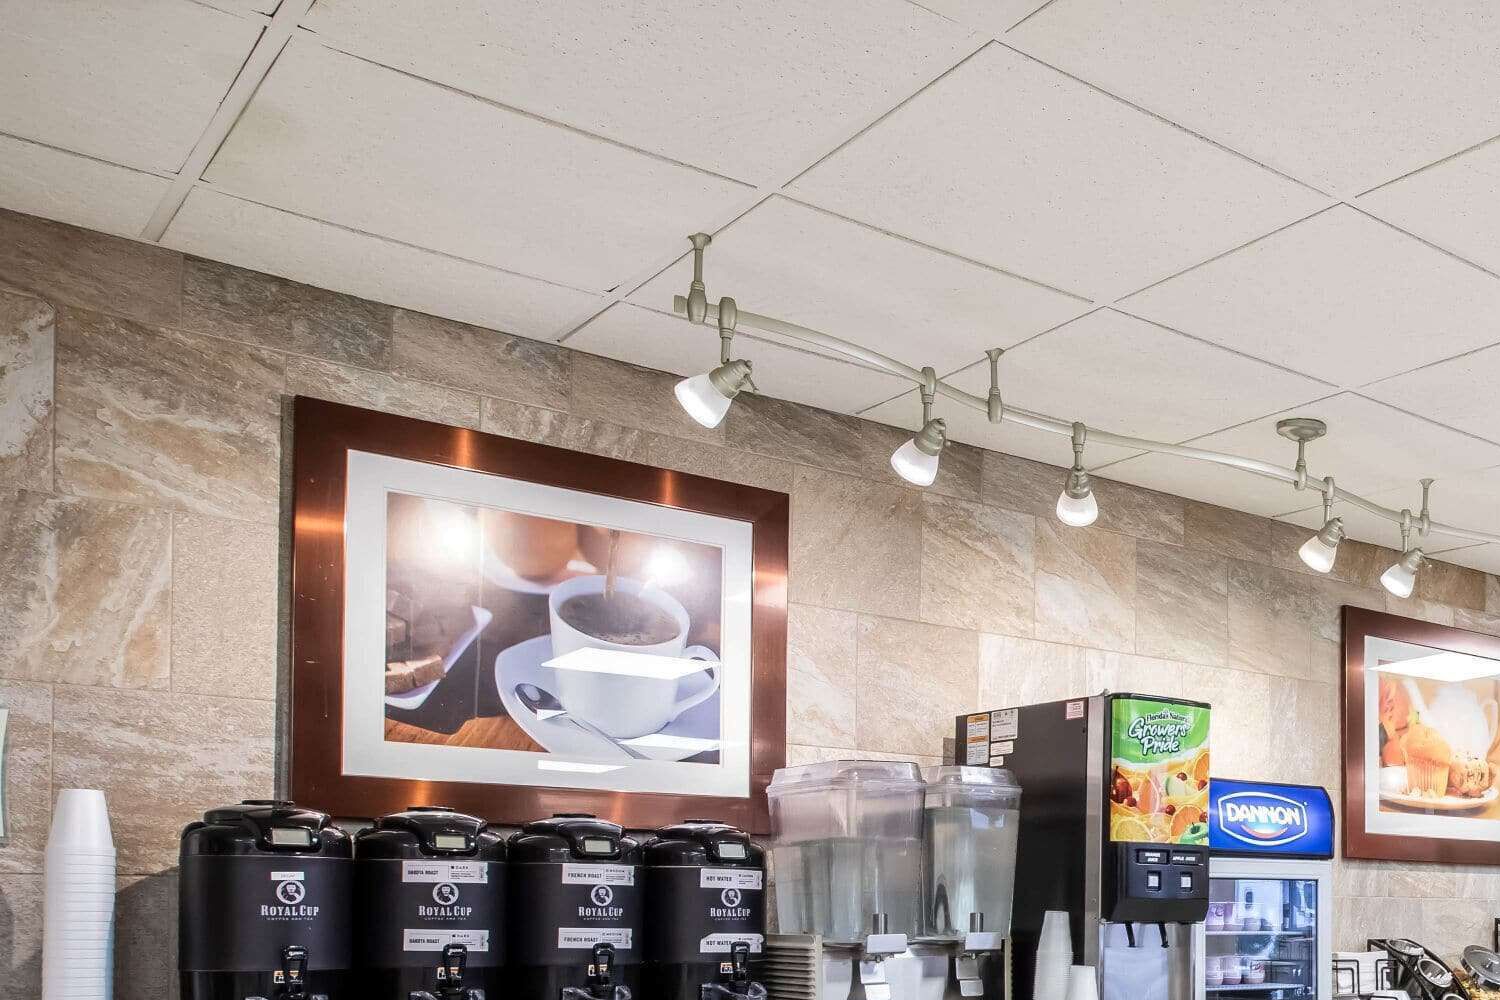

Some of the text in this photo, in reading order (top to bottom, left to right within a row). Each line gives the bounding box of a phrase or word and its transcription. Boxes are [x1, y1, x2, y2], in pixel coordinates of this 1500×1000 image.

[1141, 735, 1179, 755] Pride
[1225, 802, 1300, 826] DANNON
[261, 905, 319, 916] ROYAL CUP
[418, 905, 472, 916] ROYAL CUP
[578, 906, 624, 917] ROYAL CUP
[710, 907, 751, 917] ROYAL CUP
